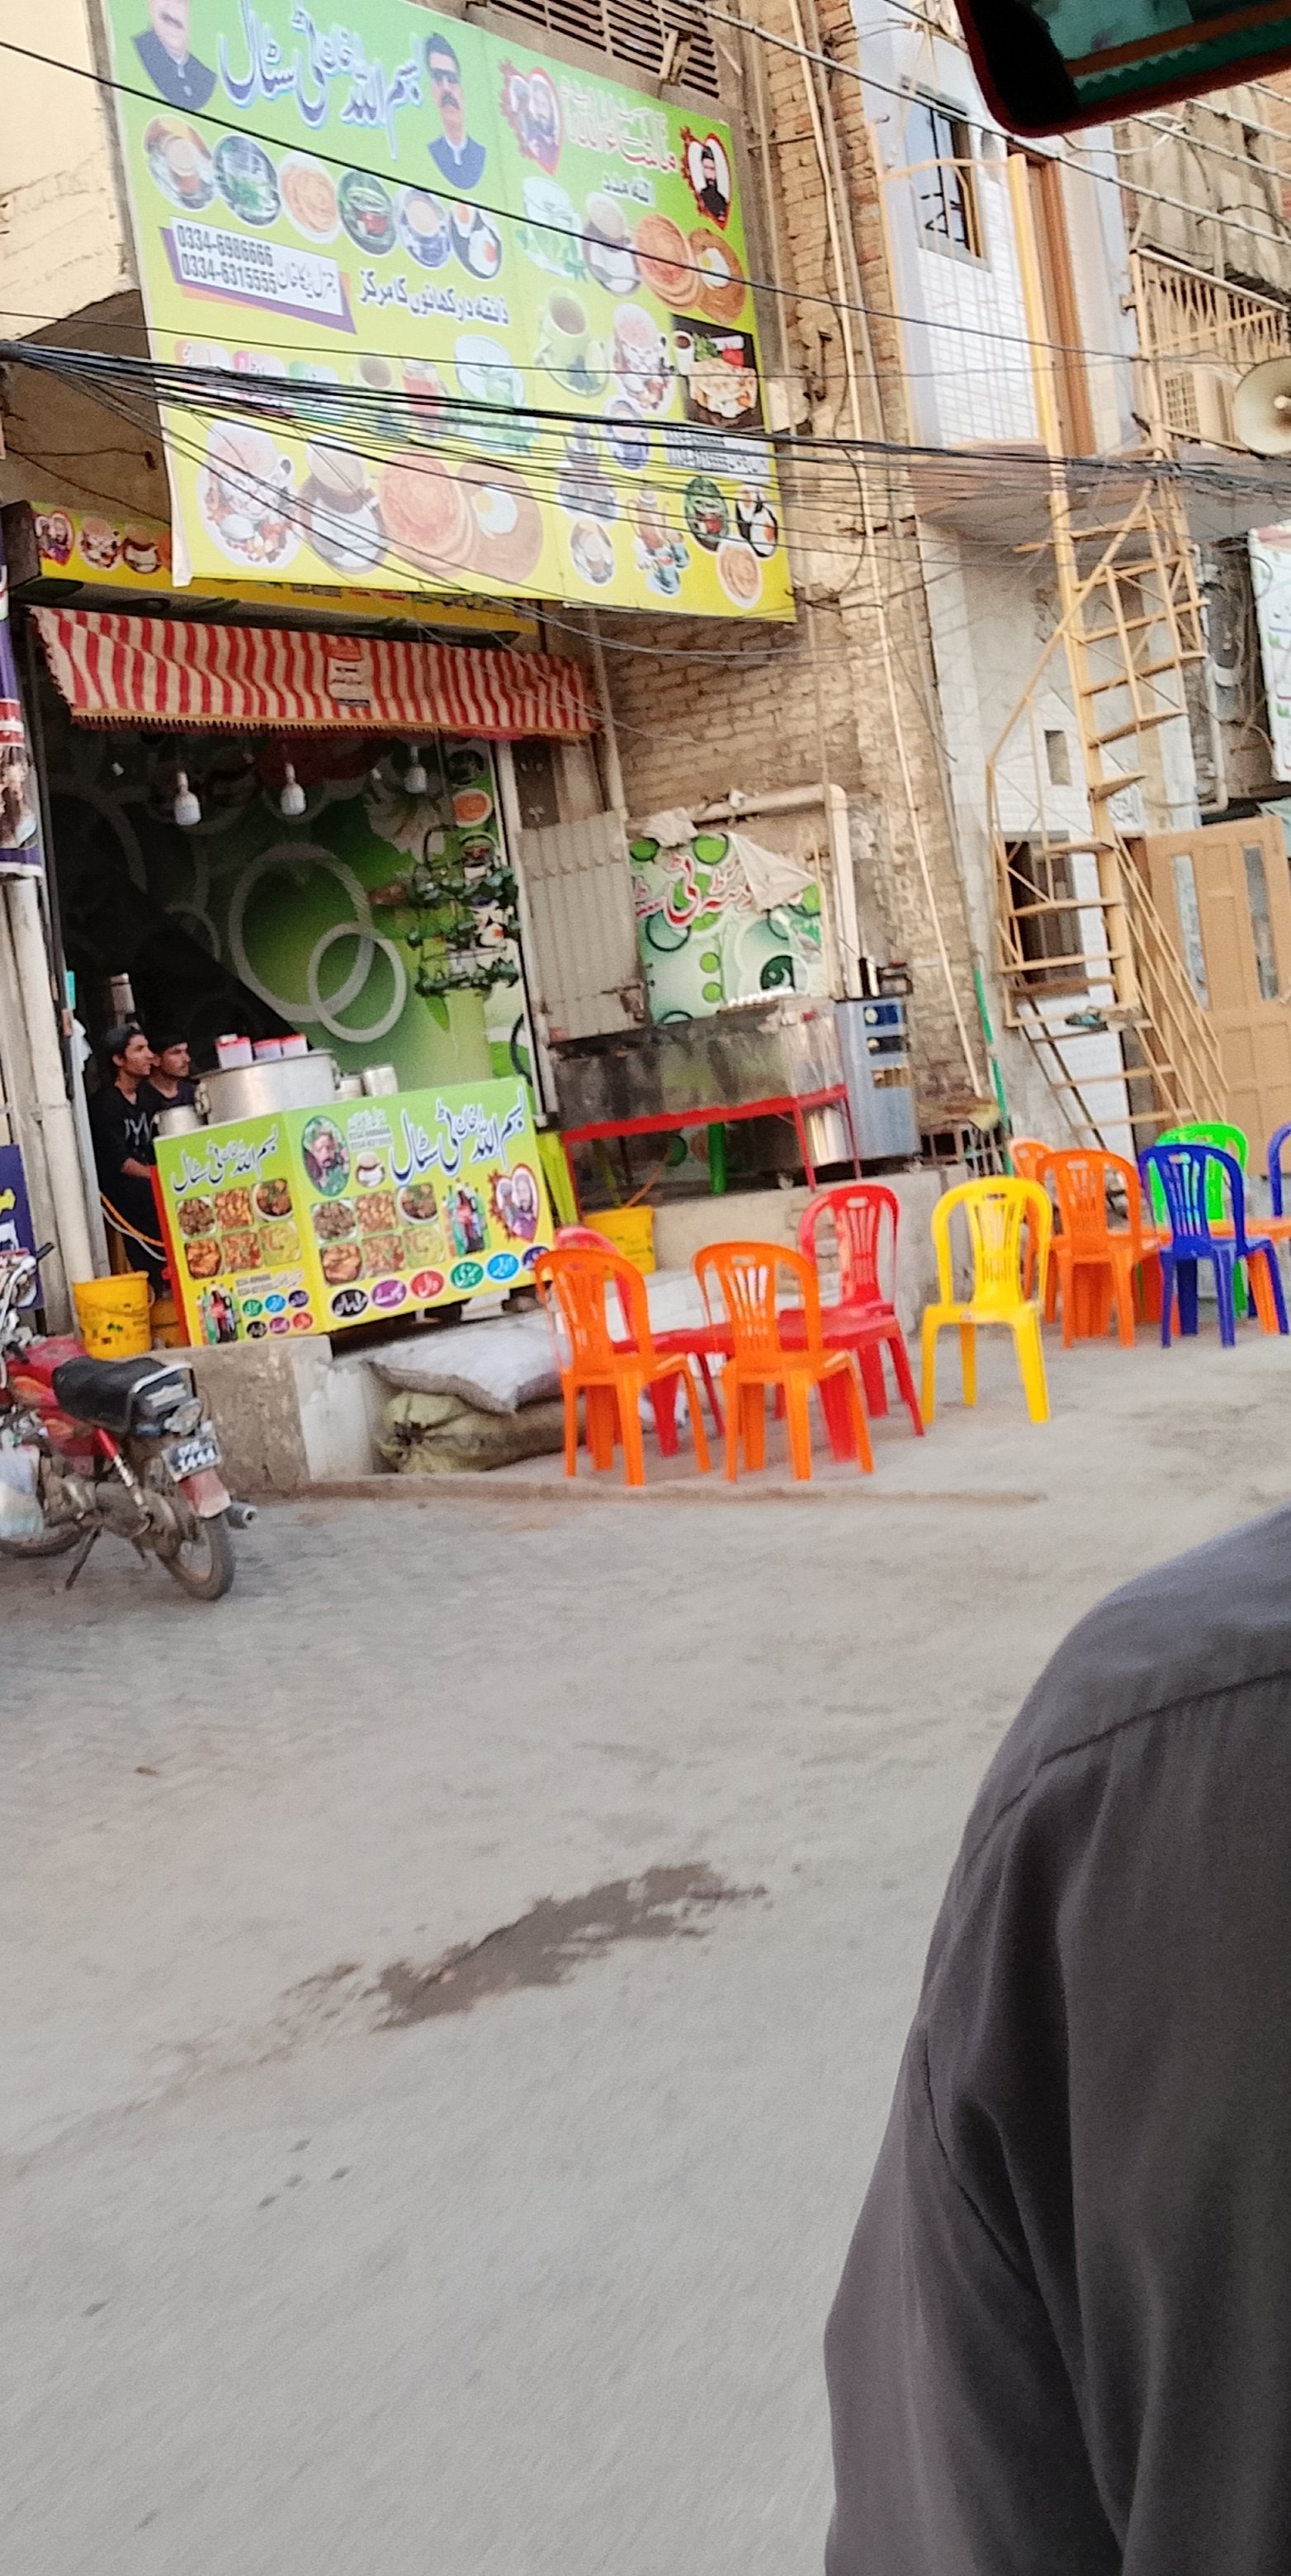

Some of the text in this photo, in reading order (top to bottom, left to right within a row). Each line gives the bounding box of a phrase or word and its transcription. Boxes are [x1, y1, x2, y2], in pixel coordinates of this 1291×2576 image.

[218, 0, 299, 109] سٹال
[291, 0, 330, 130] ٹی
[340, 33, 388, 128] اللہ
[385, 31, 424, 161] بسم
[181, 253, 277, 295] 0334-6315555
[360, 269, 394, 306] مرکز
[206, 1139, 225, 1187] ٹی
[230, 1142, 257, 1177] اللہ
[255, 1124, 279, 1183] بسم
[389, 1087, 526, 1187] بسم اللہ خان ٹی سٹال
[171, 1148, 210, 1197] سٹال
